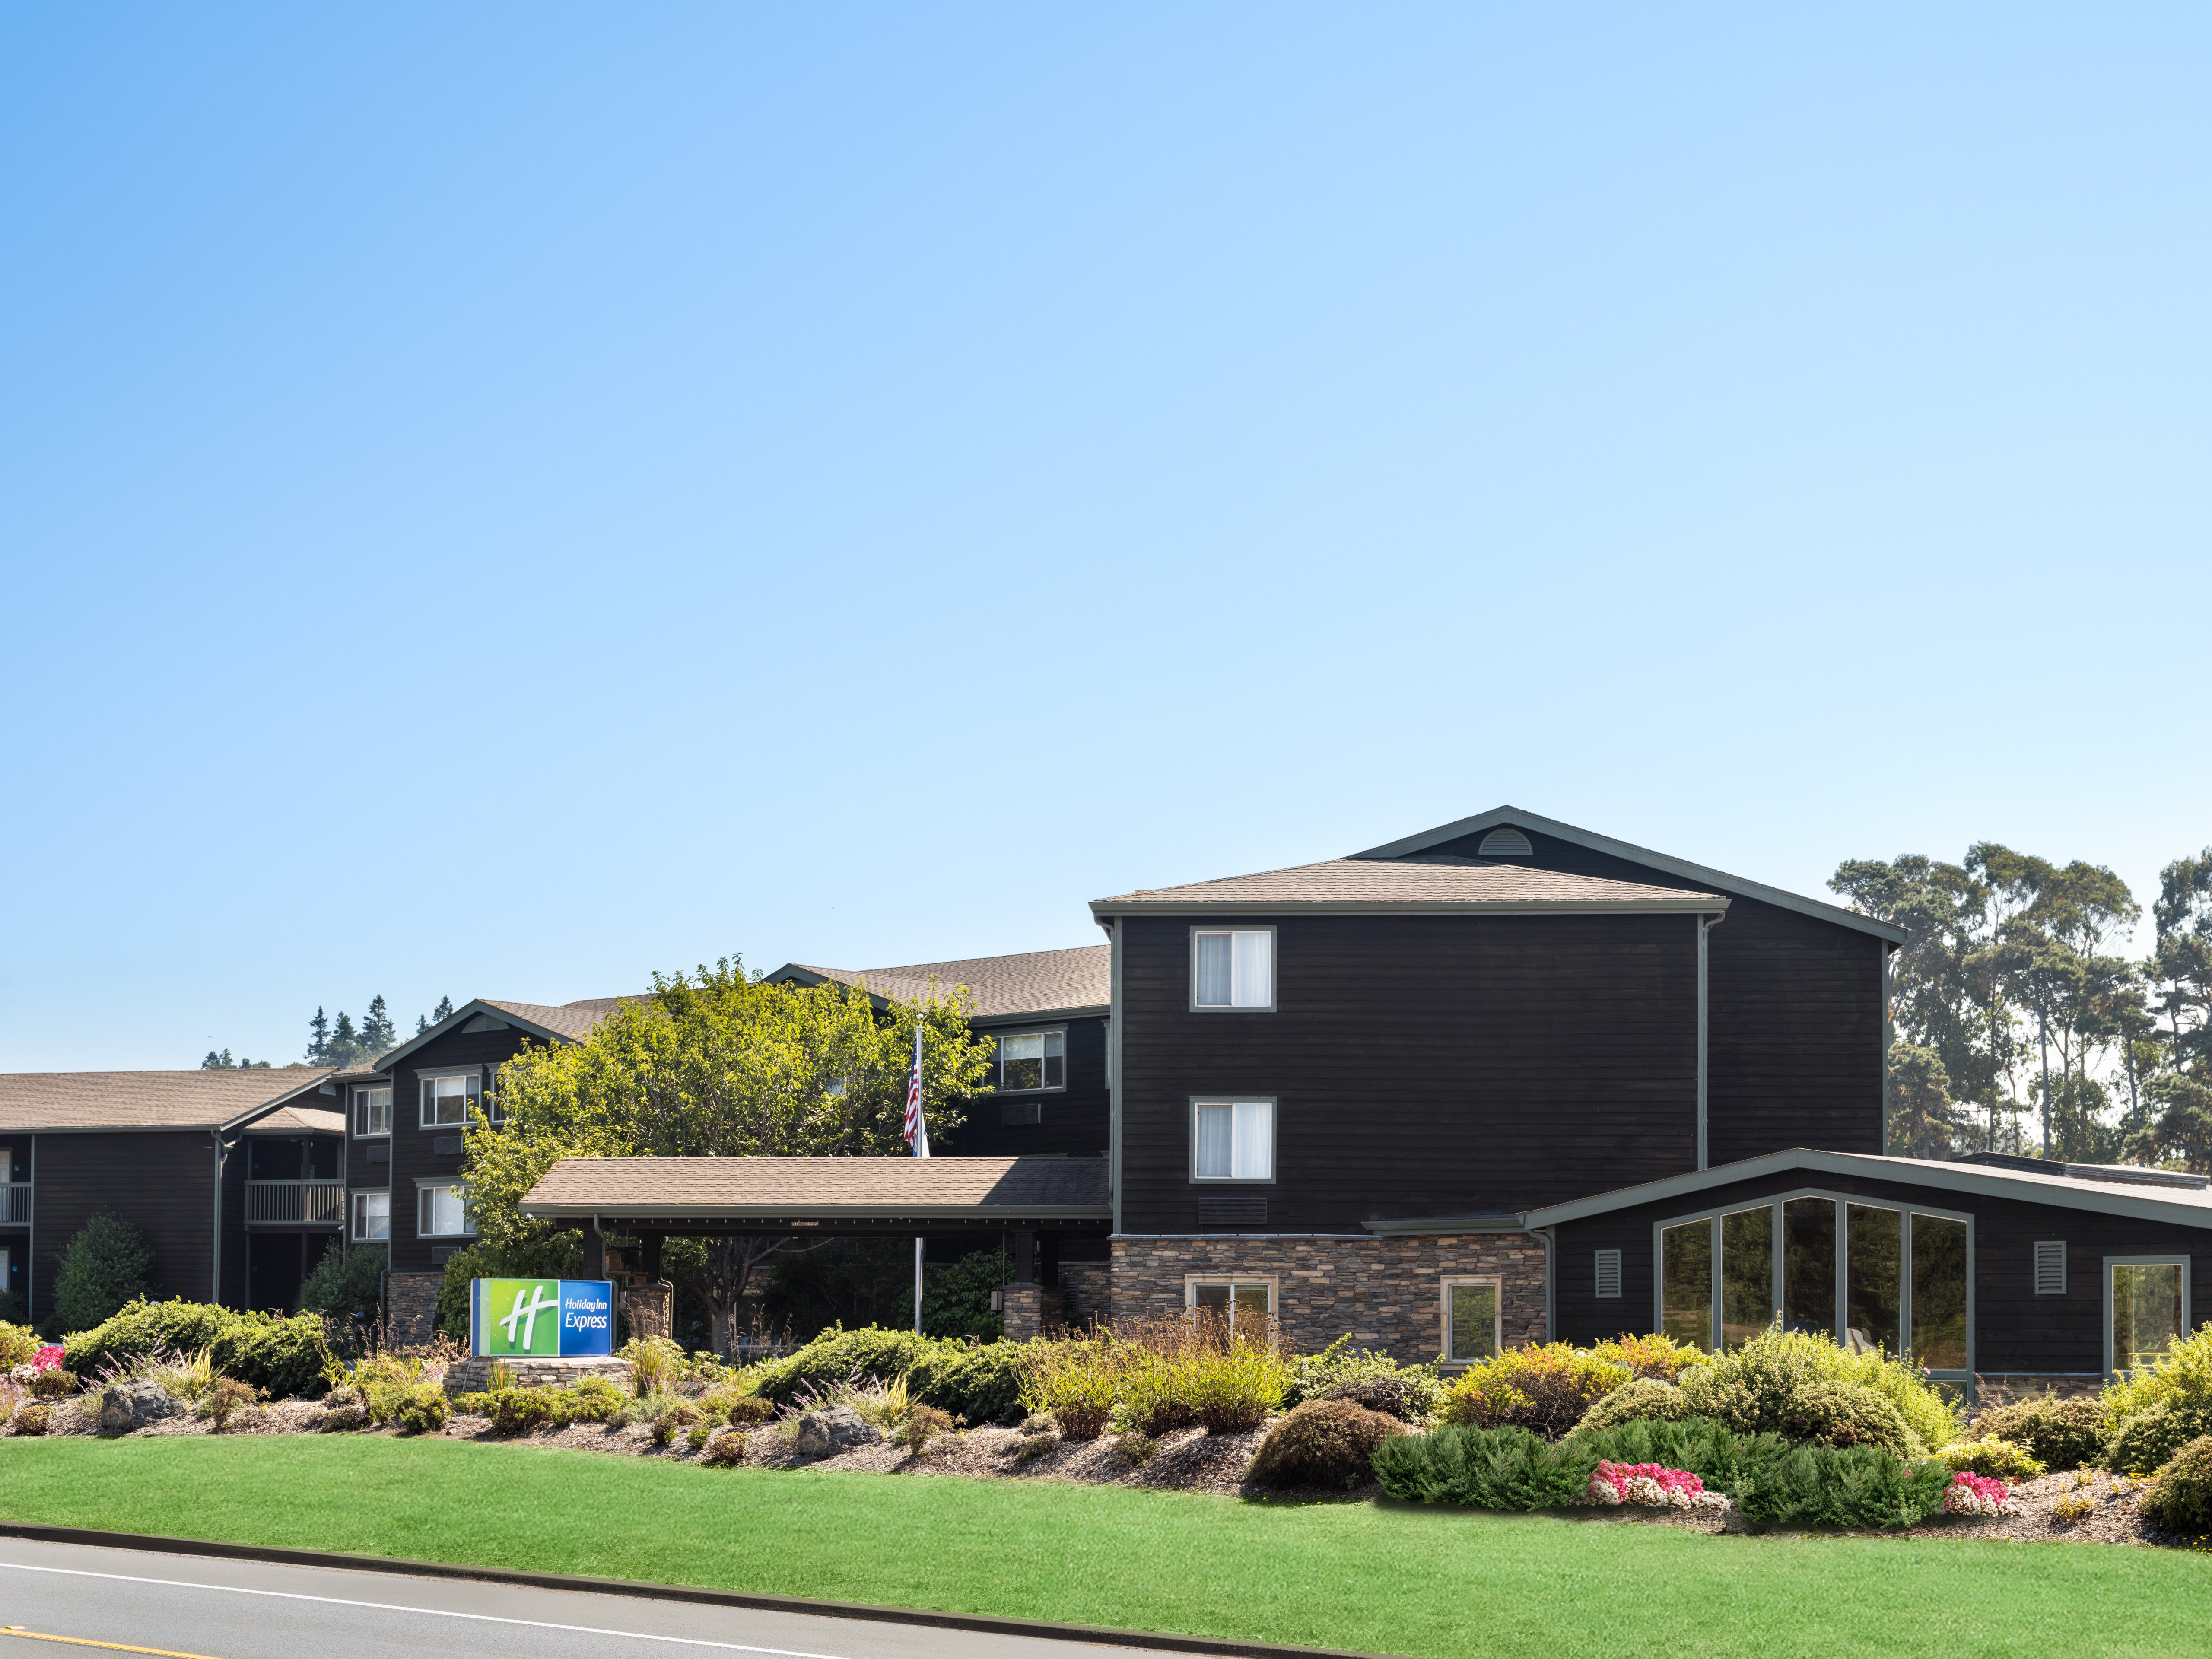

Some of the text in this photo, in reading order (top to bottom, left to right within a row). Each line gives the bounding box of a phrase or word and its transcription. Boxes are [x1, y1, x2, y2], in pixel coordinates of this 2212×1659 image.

[565, 1298, 607, 1312] Holiday Inn
[565, 1312, 607, 1332] Express
